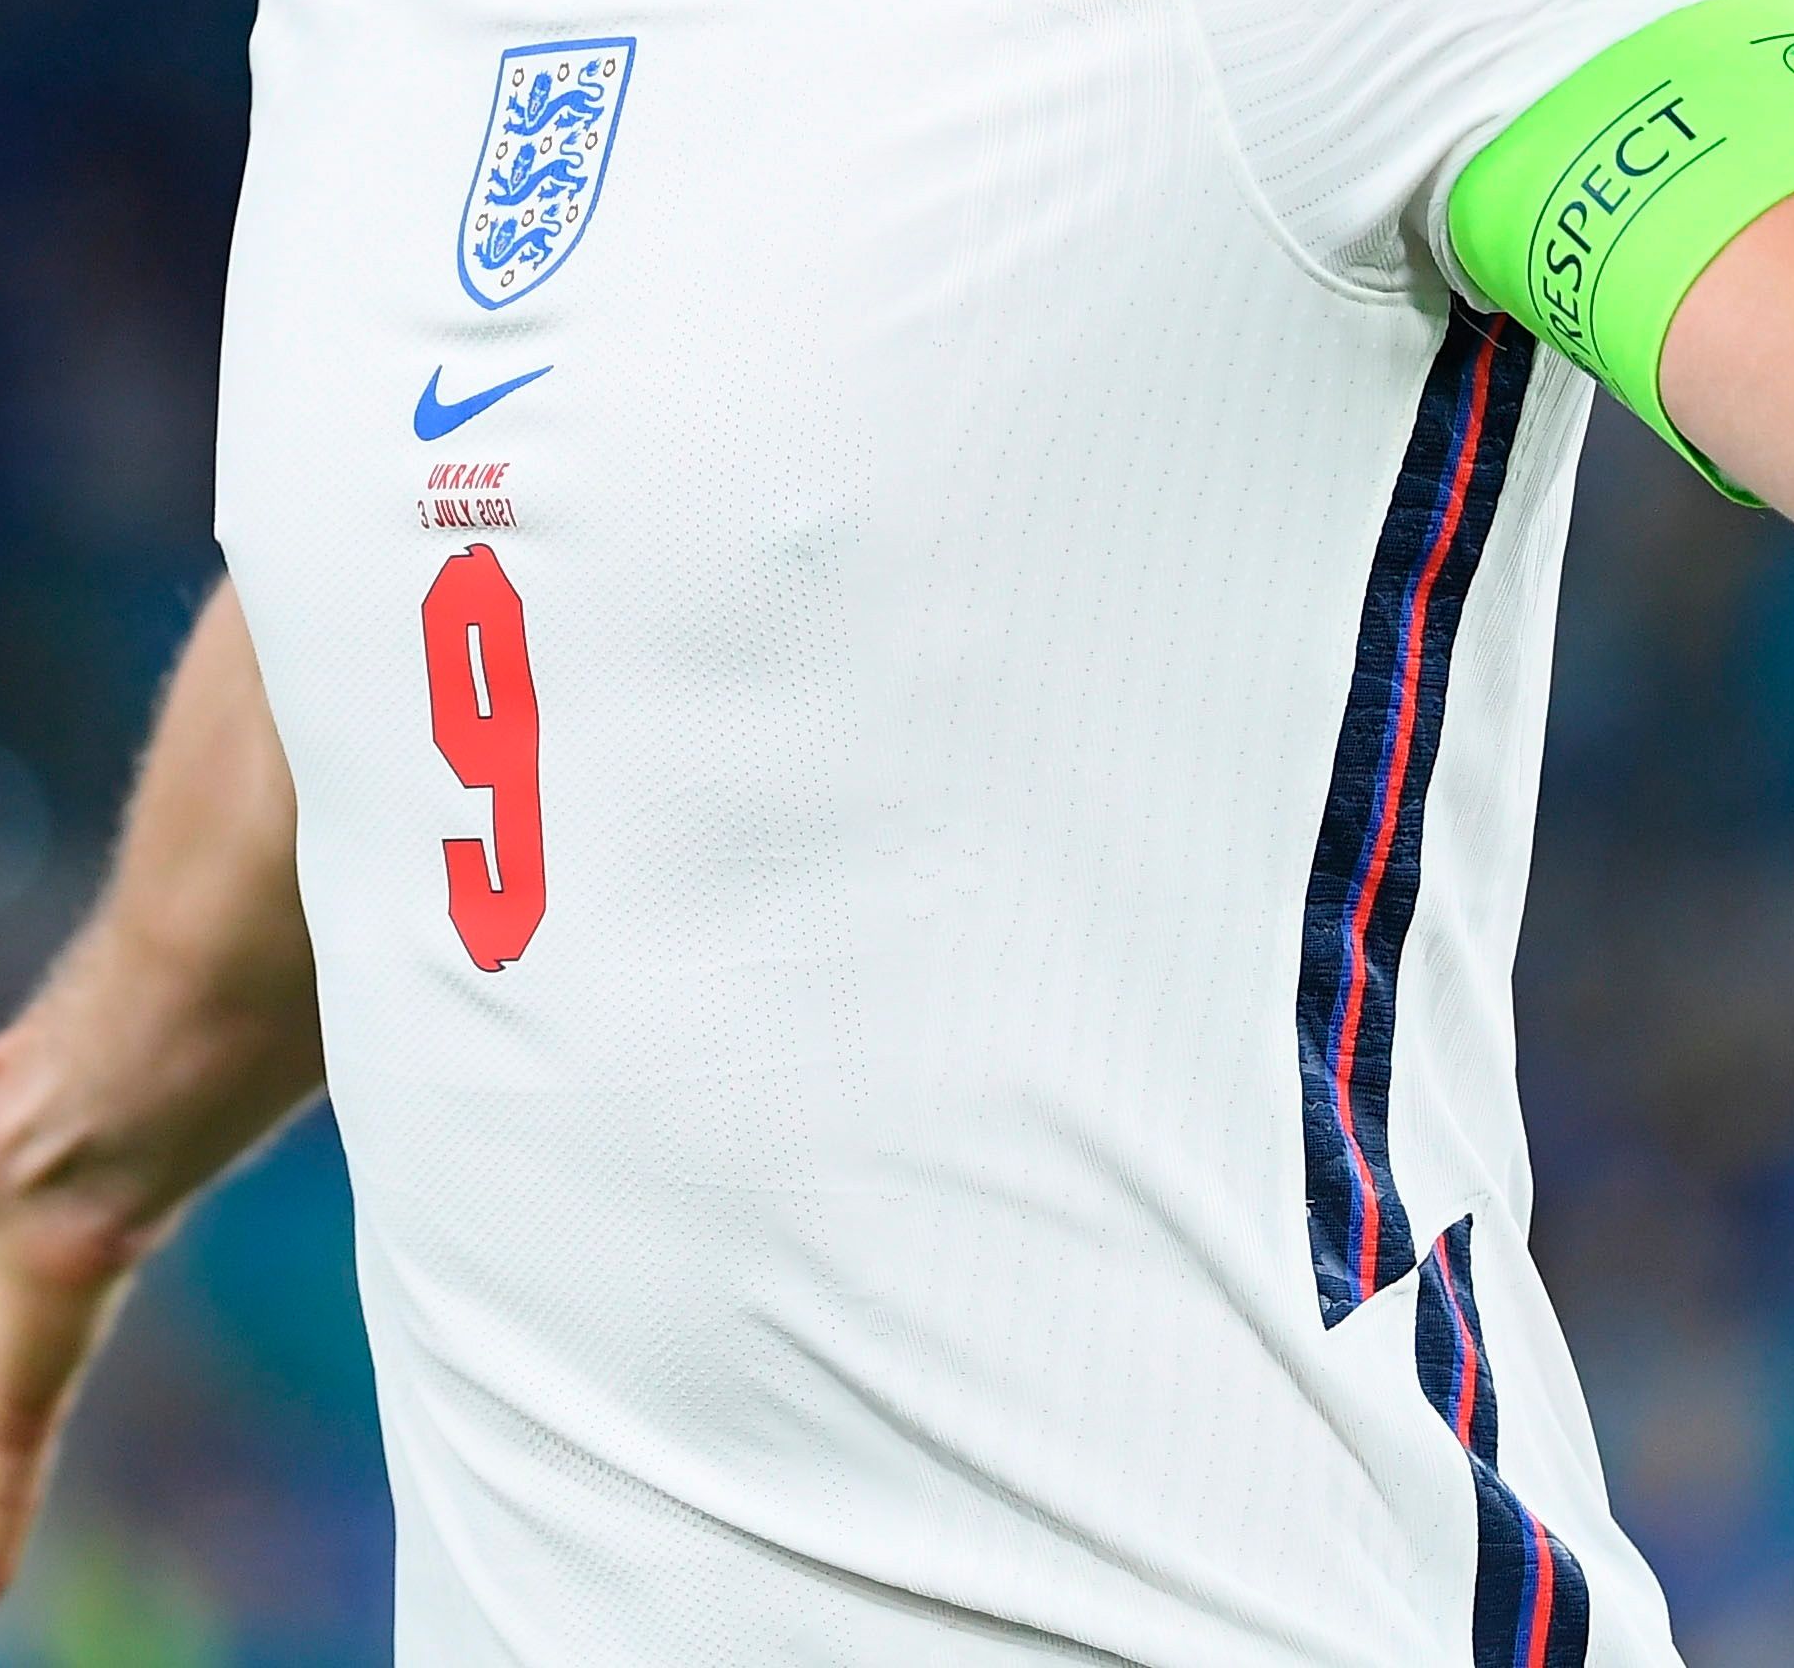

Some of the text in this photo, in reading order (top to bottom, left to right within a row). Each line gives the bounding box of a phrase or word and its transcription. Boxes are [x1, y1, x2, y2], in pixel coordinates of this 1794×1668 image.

[1543, 97, 1696, 356] RESPECT
[417, 497, 517, 529] 3 JULY 2021
[427, 462, 510, 490] UKRAINE
[422, 543, 546, 972] 9
